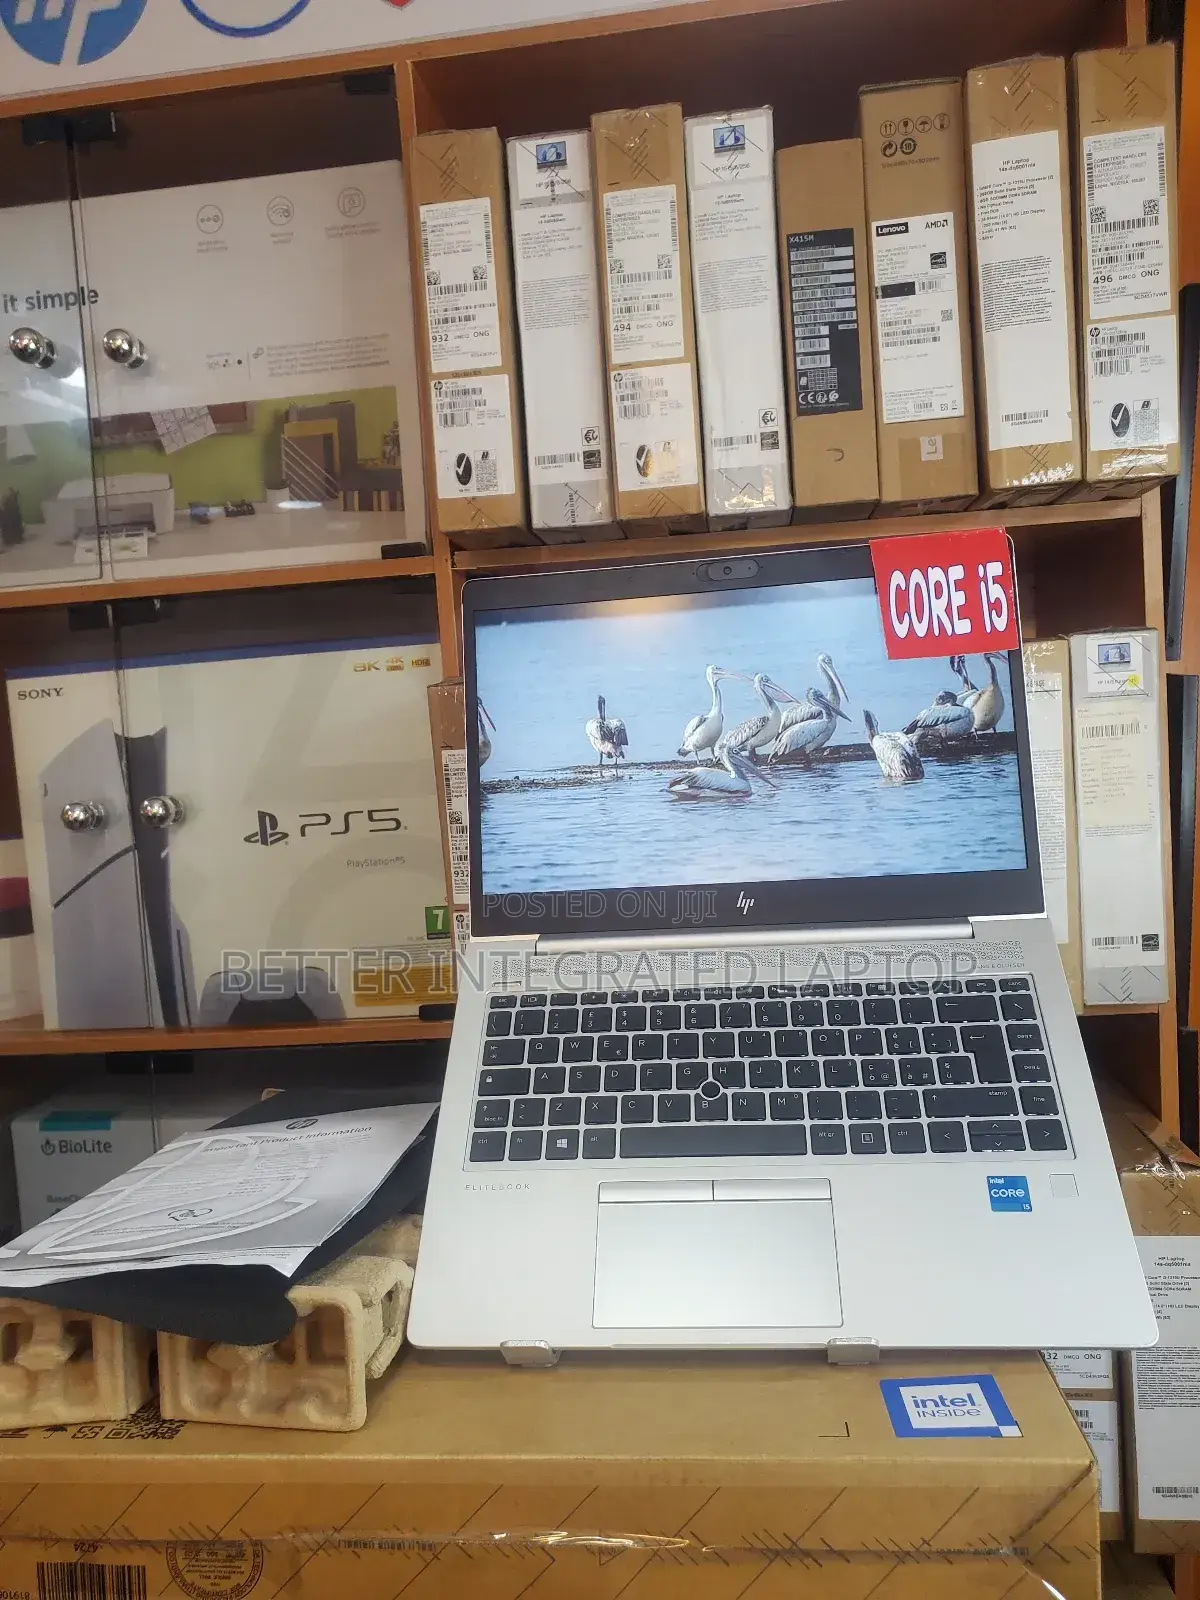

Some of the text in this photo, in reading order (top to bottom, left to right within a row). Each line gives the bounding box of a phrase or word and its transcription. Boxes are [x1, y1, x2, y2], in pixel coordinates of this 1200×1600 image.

[878, 225, 906, 235] Lenovo
[925, 220, 941, 230] AMD
[1093, 275, 1113, 285] 496
[1141, 269, 1160, 278] ONG
[3, 286, 99, 314] it simple
[613, 319, 674, 333] 494 ONG
[431, 333, 449, 344] 932
[473, 330, 490, 338] ONG
[889, 561, 1008, 639] CORE i5
[17, 687, 64, 701] SONY
[299, 808, 402, 837] PS5
[432, 909, 444, 930] 7
[260, 1135, 303, 1146] Product
[305, 1126, 372, 1139] Information
[58, 1138, 112, 1153] BioLite
[465, 1183, 530, 1191] ELITEBOOK
[911, 1393, 977, 1409] intel
